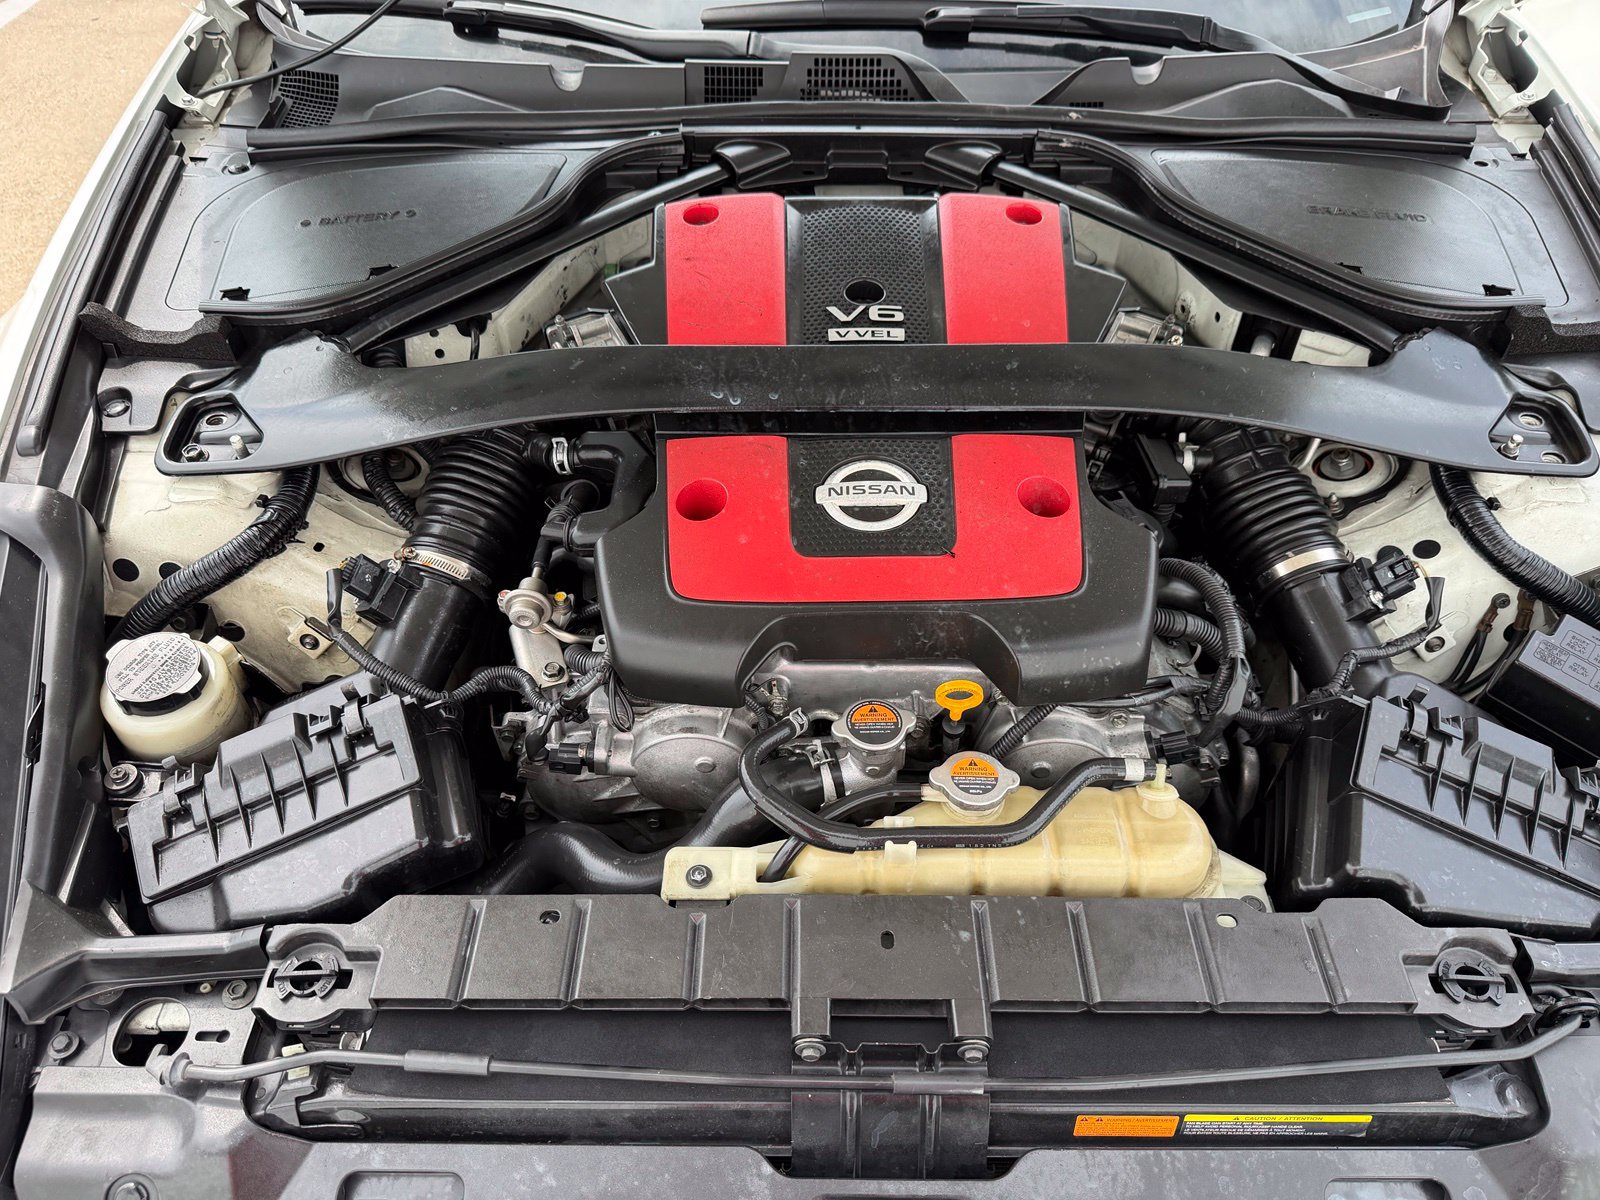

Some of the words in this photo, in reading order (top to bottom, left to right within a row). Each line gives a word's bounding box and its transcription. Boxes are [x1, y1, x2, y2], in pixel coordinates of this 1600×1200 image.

[318, 210, 400, 226] BATTERY
[1306, 204, 1370, 219] BRAKE
[1373, 208, 1427, 222] FLUID
[825, 304, 905, 322] V6
[834, 330, 899, 338] VVEL
[827, 484, 916, 497] NISSAN
[1569, 640, 1586, 651] LOCK
[1572, 635, 1589, 646] SHIFT
[1566, 643, 1585, 654] RELAY
[1568, 665, 1589, 677] RELAY
